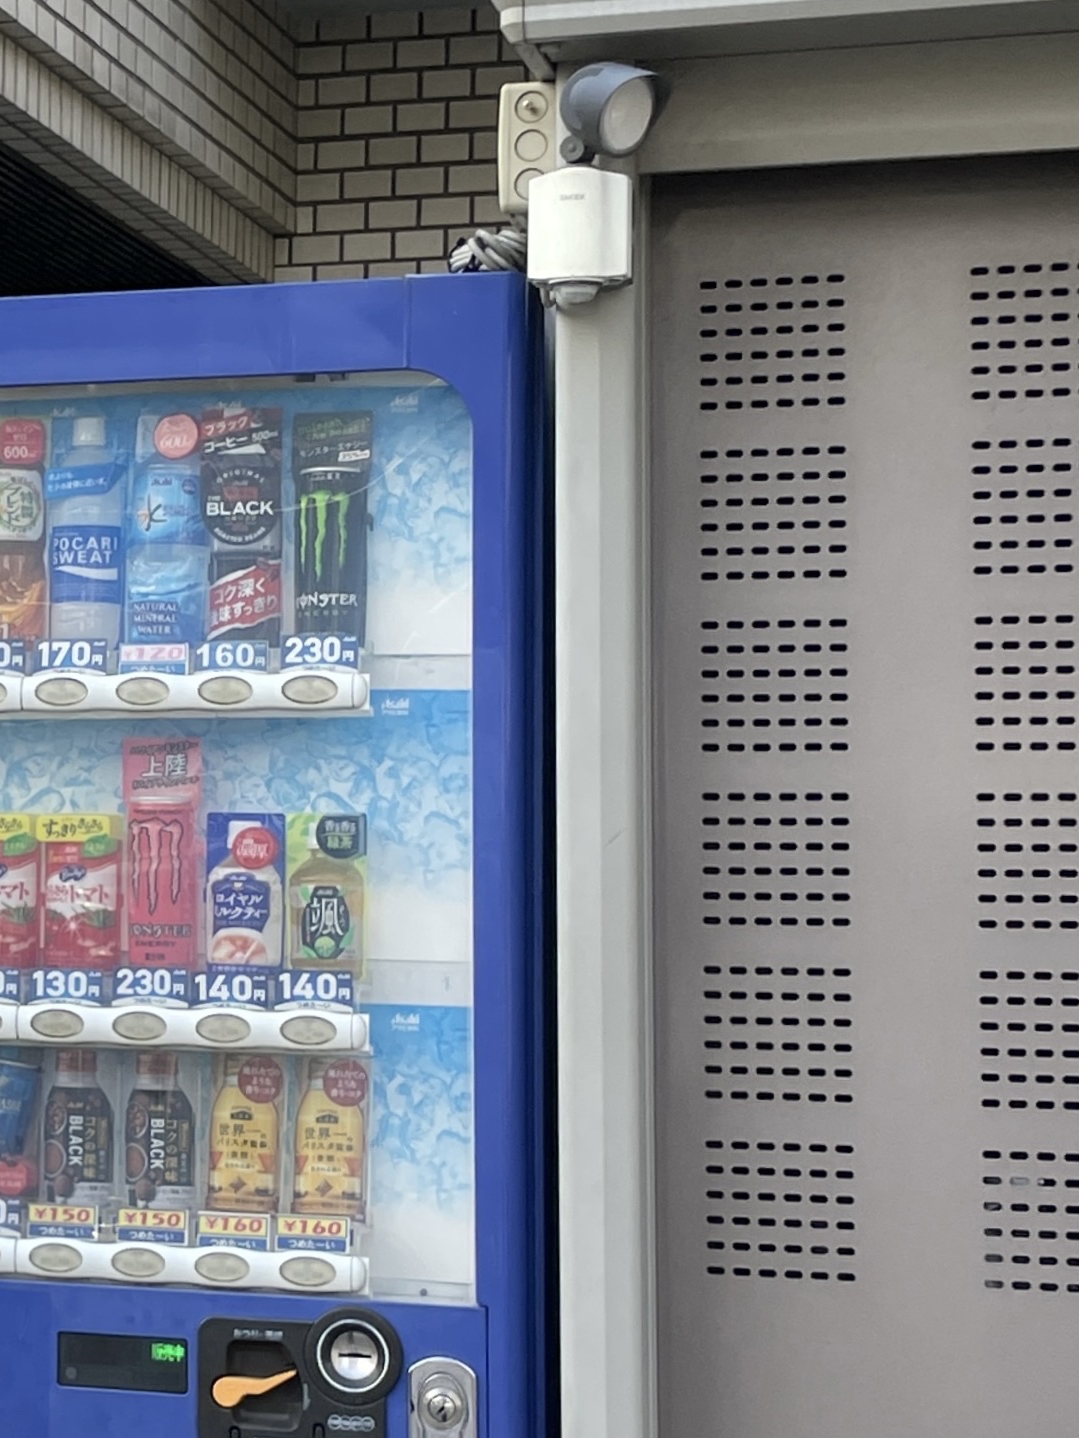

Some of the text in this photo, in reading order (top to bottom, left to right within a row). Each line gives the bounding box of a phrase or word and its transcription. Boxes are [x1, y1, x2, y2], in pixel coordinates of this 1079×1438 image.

[205, 416, 249, 436] ブラック
[204, 436, 248, 454] コーヒー
[206, 500, 275, 516] BLACK
[53, 535, 118, 550] POCARI
[52, 549, 113, 565] SWEAT
[214, 576, 266, 606] コク深く
[133, 602, 178, 613] NATURAL
[133, 613, 177, 624] MINERAL
[137, 624, 172, 635] WATER
[37, 640, 103, 667] 170円
[123, 645, 183, 661] ¥120
[195, 643, 266, 668] 160円
[284, 635, 355, 664] 230円
[381, 697, 410, 709] Asahi
[141, 753, 187, 777] 上陸
[42, 819, 78, 838] すっきり
[215, 893, 264, 907] ロイヤル
[214, 905, 268, 920] ミルクティー
[310, 896, 344, 936] 颯
[32, 970, 100, 998] 130円
[116, 968, 185, 996] 230円
[194, 973, 266, 1001] 140円
[278, 972, 351, 1001] 140円
[390, 1012, 420, 1025] Asahi
[68, 1115, 84, 1167] BLACK
[149, 1118, 165, 1170] BLACK
[33, 1206, 91, 1222] ¥150
[123, 1210, 181, 1228] ¥150
[205, 1216, 263, 1234] ¥160
[282, 1219, 342, 1236] ¥160
